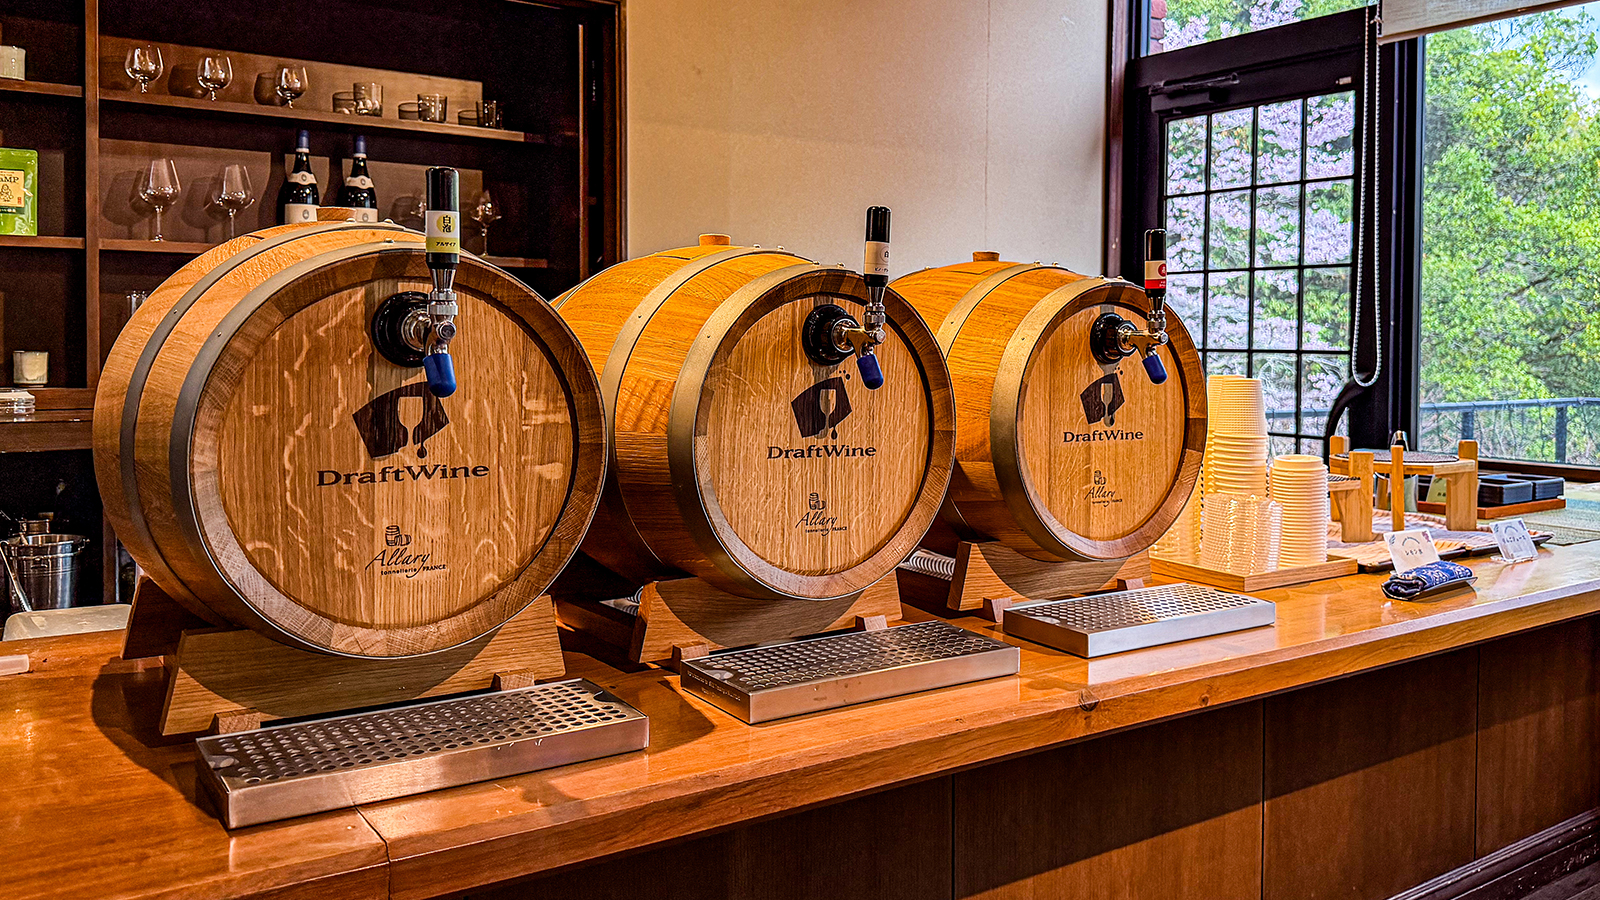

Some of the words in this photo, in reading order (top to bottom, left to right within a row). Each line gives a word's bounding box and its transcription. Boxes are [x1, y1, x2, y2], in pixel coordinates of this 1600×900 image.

[1063, 429, 1144, 443] DraftWine
[766, 444, 877, 460] DraftWine
[316, 463, 490, 487] DraftWine
[1083, 485, 1116, 508] Allary
[795, 510, 838, 537] Allary
[364, 546, 431, 579] Allary
[422, 563, 447, 572] FRANCE
